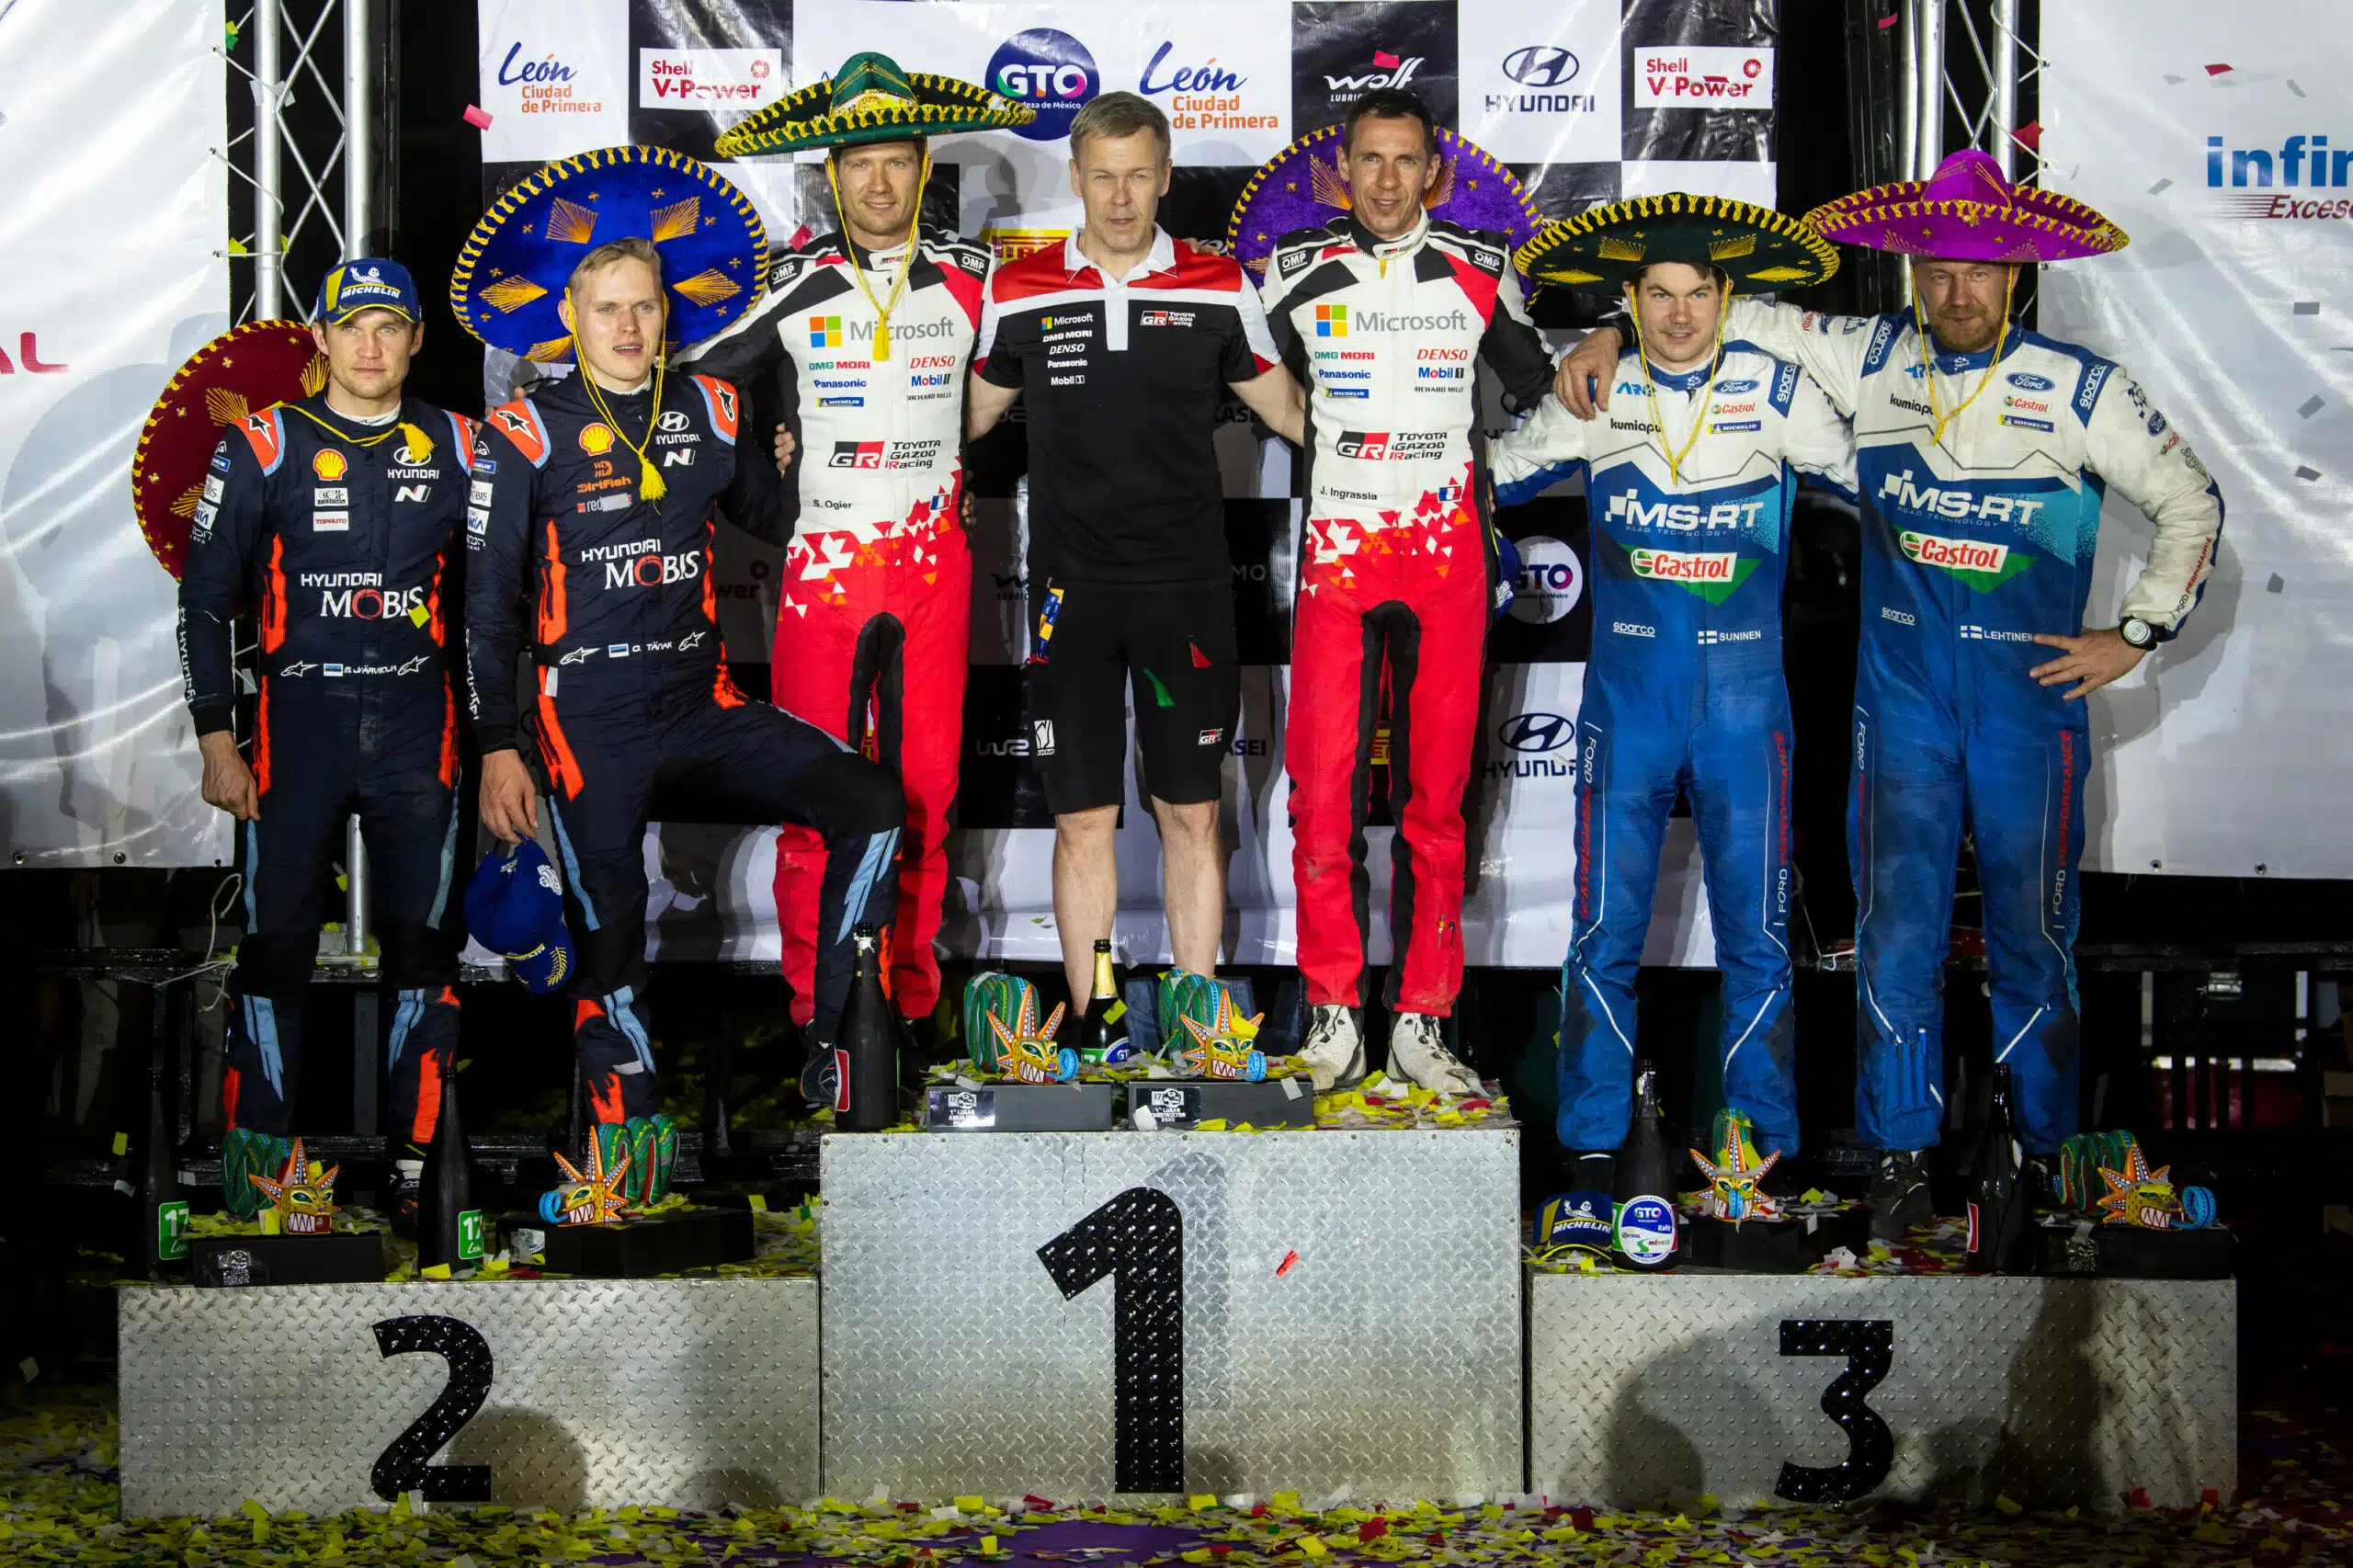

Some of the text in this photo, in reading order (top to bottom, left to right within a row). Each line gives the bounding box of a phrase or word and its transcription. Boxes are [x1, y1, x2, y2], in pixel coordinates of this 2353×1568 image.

[498, 41, 577, 85] León
[652, 59, 693, 75] Shell
[1139, 40, 1247, 96] León
[1646, 58, 1688, 74] Shell
[997, 63, 1088, 98] GTO
[1647, 75, 1753, 99] V-Power
[521, 85, 573, 99] Ciudad
[652, 79, 761, 100] V-Power
[521, 100, 602, 113] de Primera
[1040, 100, 1051, 108] de
[1052, 100, 1082, 109] México
[1173, 95, 1240, 111] Ciudad
[1484, 95, 1596, 113] HYUNDAI
[1173, 113, 1279, 130] de Primera
[2267, 194, 2353, 220] Exces
[961, 255, 985, 270] OMP
[1281, 252, 1307, 268] OMP
[1474, 252, 1500, 267] OMP
[770, 265, 796, 281] OMP
[340, 286, 400, 300] MICHELIN
[1054, 312, 1094, 325] Microsoft
[1356, 309, 1468, 332] Microsoft
[1042, 329, 1093, 343] DMG MORI
[1867, 320, 1893, 366] sparco
[1049, 343, 1086, 355] DENSO
[1314, 351, 1375, 360] DMG MORI
[1416, 348, 1468, 361] DENSO
[809, 360, 870, 370] DMG MORI
[909, 355, 957, 369] DENSO
[1047, 358, 1087, 369] Panasonic
[1318, 369, 1371, 379] Panasonic
[813, 378, 867, 388] Panasonic
[2079, 364, 2108, 410] sparco
[906, 392, 952, 402] RICHARD MILLE
[2013, 397, 2050, 413] Castrol
[1722, 403, 1756, 415] Castrol
[1722, 423, 1757, 432] MICHELIN
[2013, 418, 2051, 430] MICHELIN
[892, 439, 941, 450] TOYOTA
[1396, 432, 1448, 441] TOYOTA
[1392, 441, 1445, 451] GAZOO
[890, 449, 937, 460] GAZOO
[1389, 450, 1443, 460] Racing
[885, 460, 933, 470] Racing
[387, 469, 440, 480] HYUNDAI
[577, 476, 632, 494] DirtFish
[1319, 485, 1378, 502] J. Ingrassia
[813, 499, 853, 510] S. Ogier
[1898, 482, 2045, 525] MS-RT
[1625, 500, 1765, 531] MS-RT
[581, 538, 662, 562] HYUNDAI
[1920, 539, 2000, 568] Castrol
[604, 551, 700, 590] MOBIS
[1654, 553, 1729, 579] Castrol
[301, 573, 383, 587] HYUNDAI
[320, 585, 424, 620] MOBIS
[1881, 607, 1915, 625] sparco
[1612, 621, 1655, 637] sparco
[1719, 630, 1762, 642] SUNINEN
[1984, 629, 2033, 642] LEHTINEN
[1857, 721, 1867, 770] FORD
[1585, 736, 1597, 784] FORD
[1779, 869, 1788, 913] FORD
[2052, 869, 2066, 915] FORD
[1634, 1207, 1662, 1220] GTO
[1552, 1221, 1612, 1235] MICHELIN
[1657, 1224, 1671, 1233] Rally
[1037, 1187, 1186, 1493] 1
[372, 1314, 493, 1502] 2
[1779, 1320, 1894, 1502] 3
